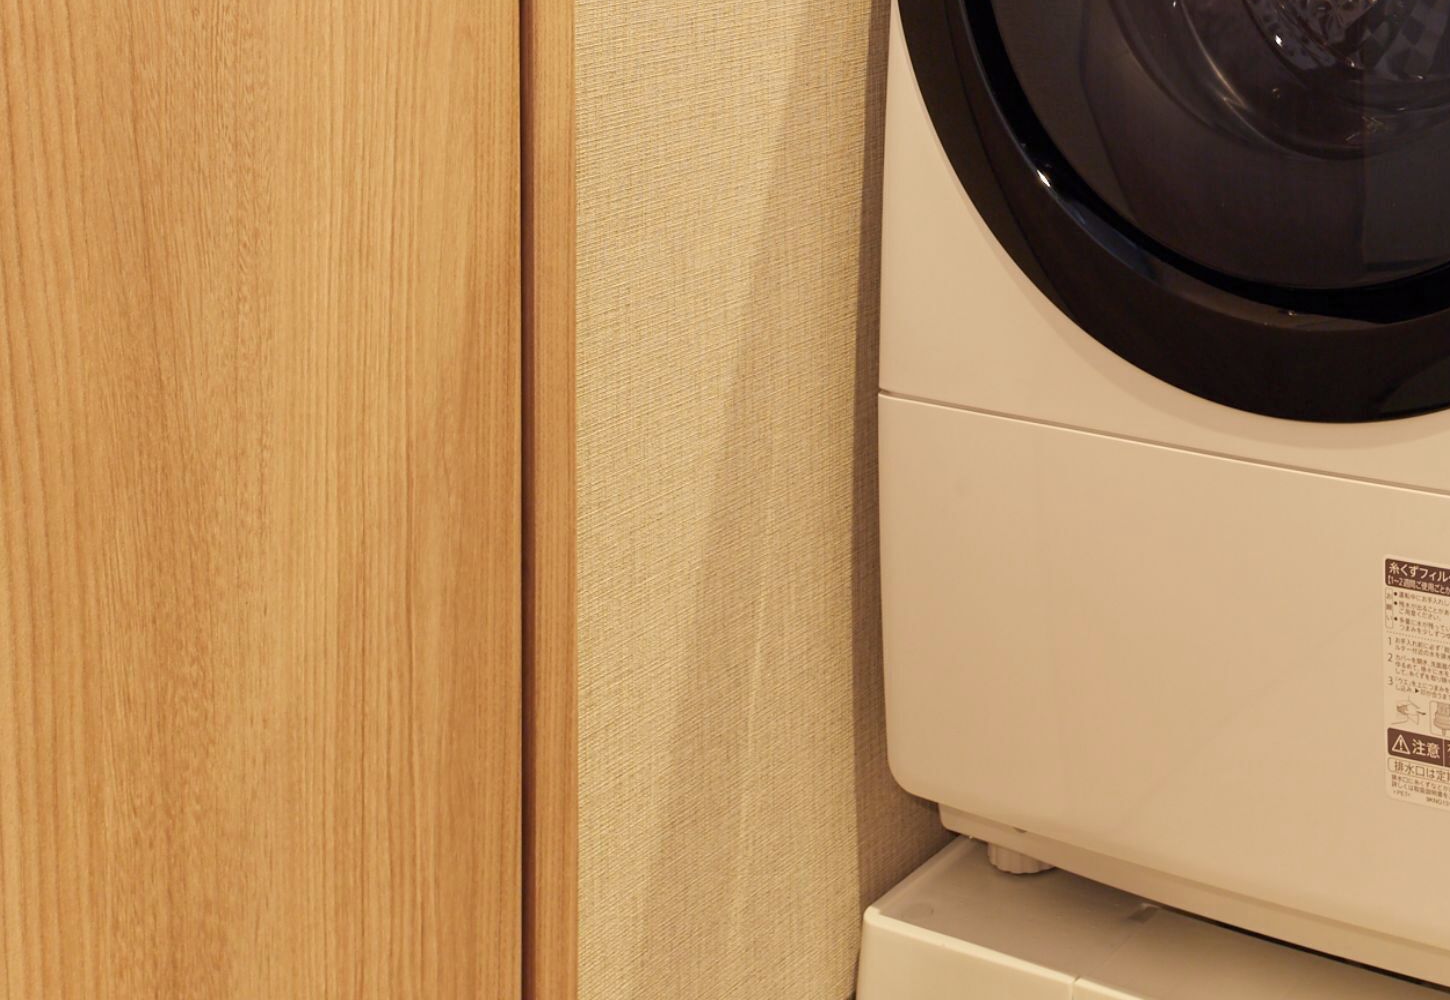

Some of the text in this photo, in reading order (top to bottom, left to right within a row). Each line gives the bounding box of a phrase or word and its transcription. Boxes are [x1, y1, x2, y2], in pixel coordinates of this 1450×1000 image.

[1387, 652, 1393, 662] 2
[1386, 675, 1393, 685] 3
[1411, 737, 1440, 759] 注意
